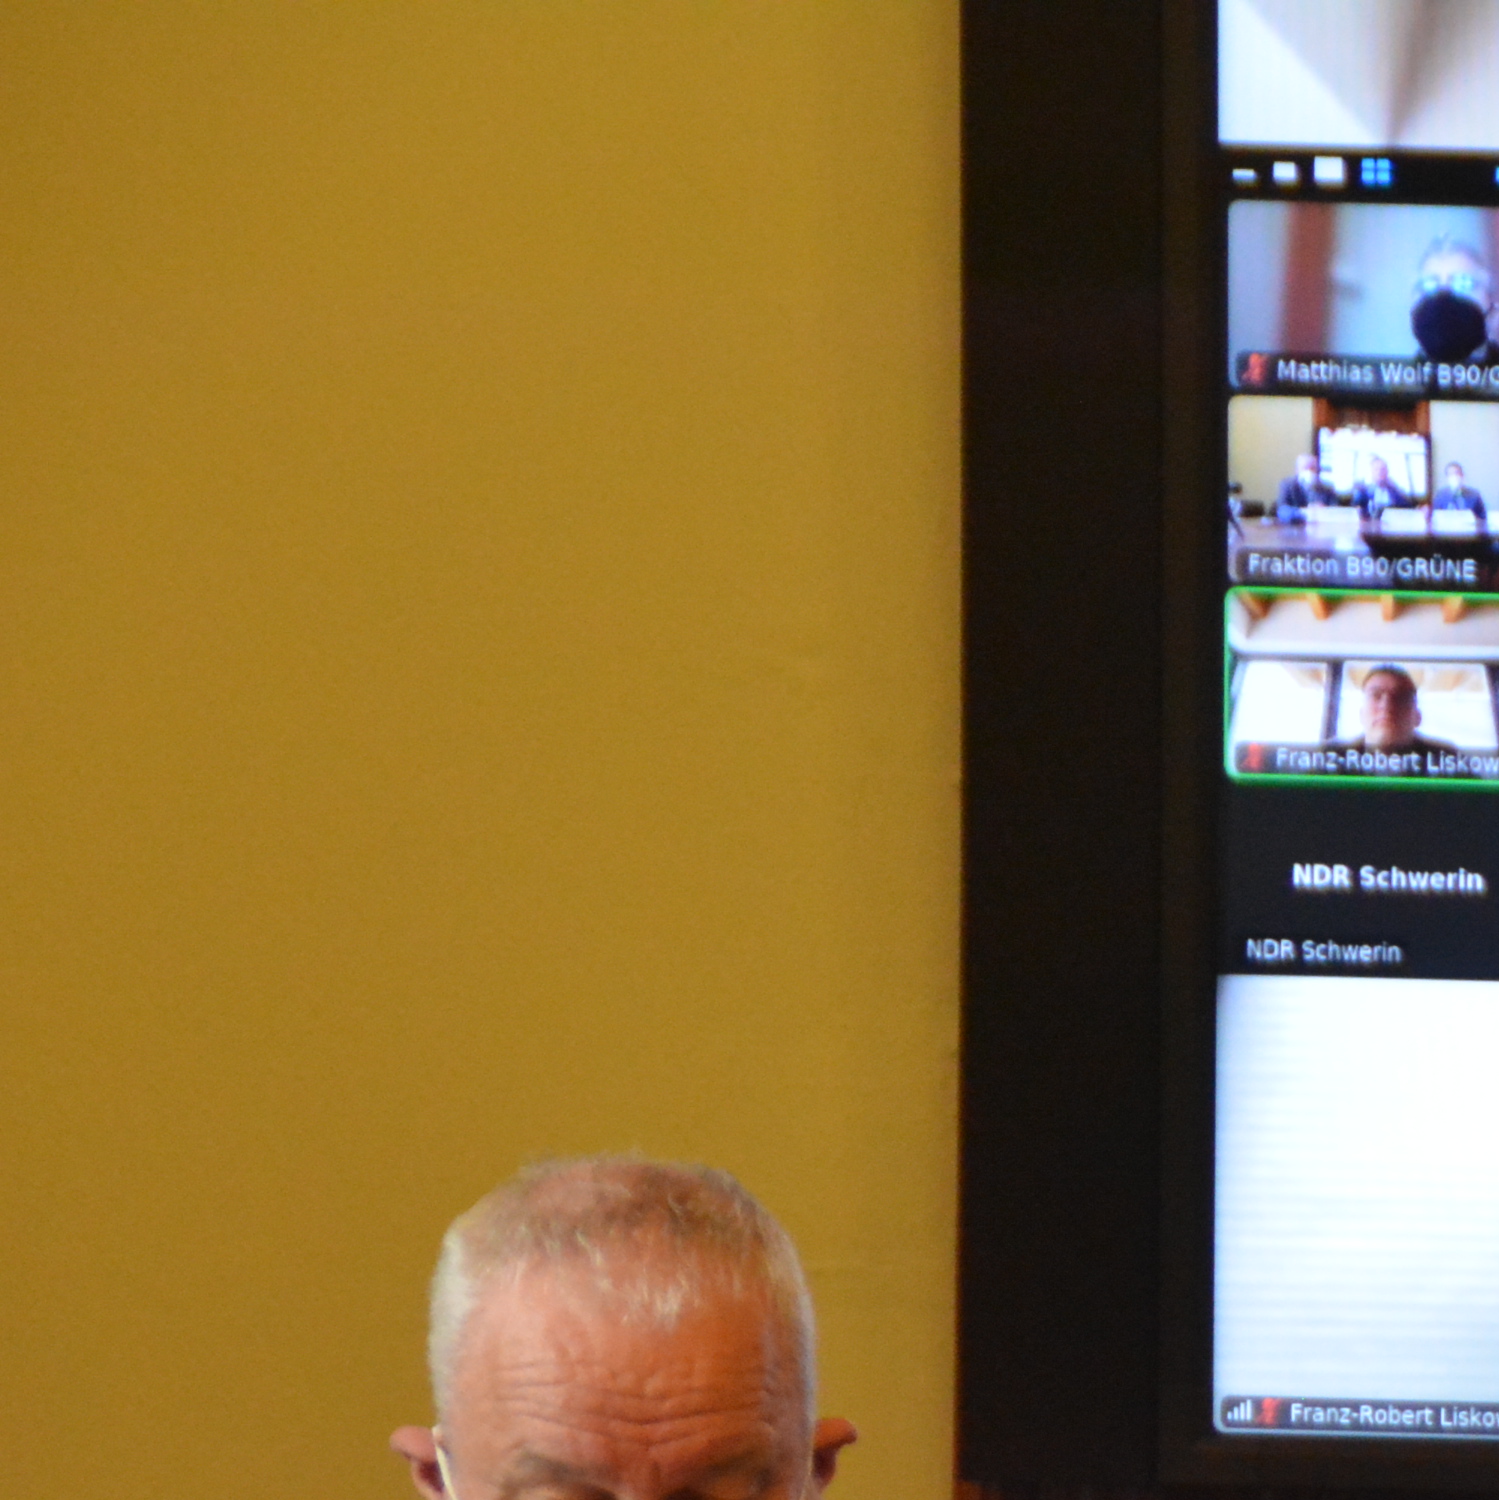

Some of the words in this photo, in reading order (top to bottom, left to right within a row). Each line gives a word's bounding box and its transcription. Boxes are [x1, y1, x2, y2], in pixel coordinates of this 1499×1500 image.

[1277, 359, 1373, 383] Matthias
[1380, 362, 1432, 384] Wolf
[1248, 553, 1339, 576] Fraktion
[1275, 747, 1419, 770] Franz-Robert
[1426, 750, 1499, 773] Liskow
[1292, 863, 1350, 887] NDR
[1359, 865, 1485, 891] Schwerin
[1246, 938, 1295, 959] NDR
[1301, 939, 1401, 962] Schwerin
[1290, 1402, 1433, 1426] Franz-Robert
